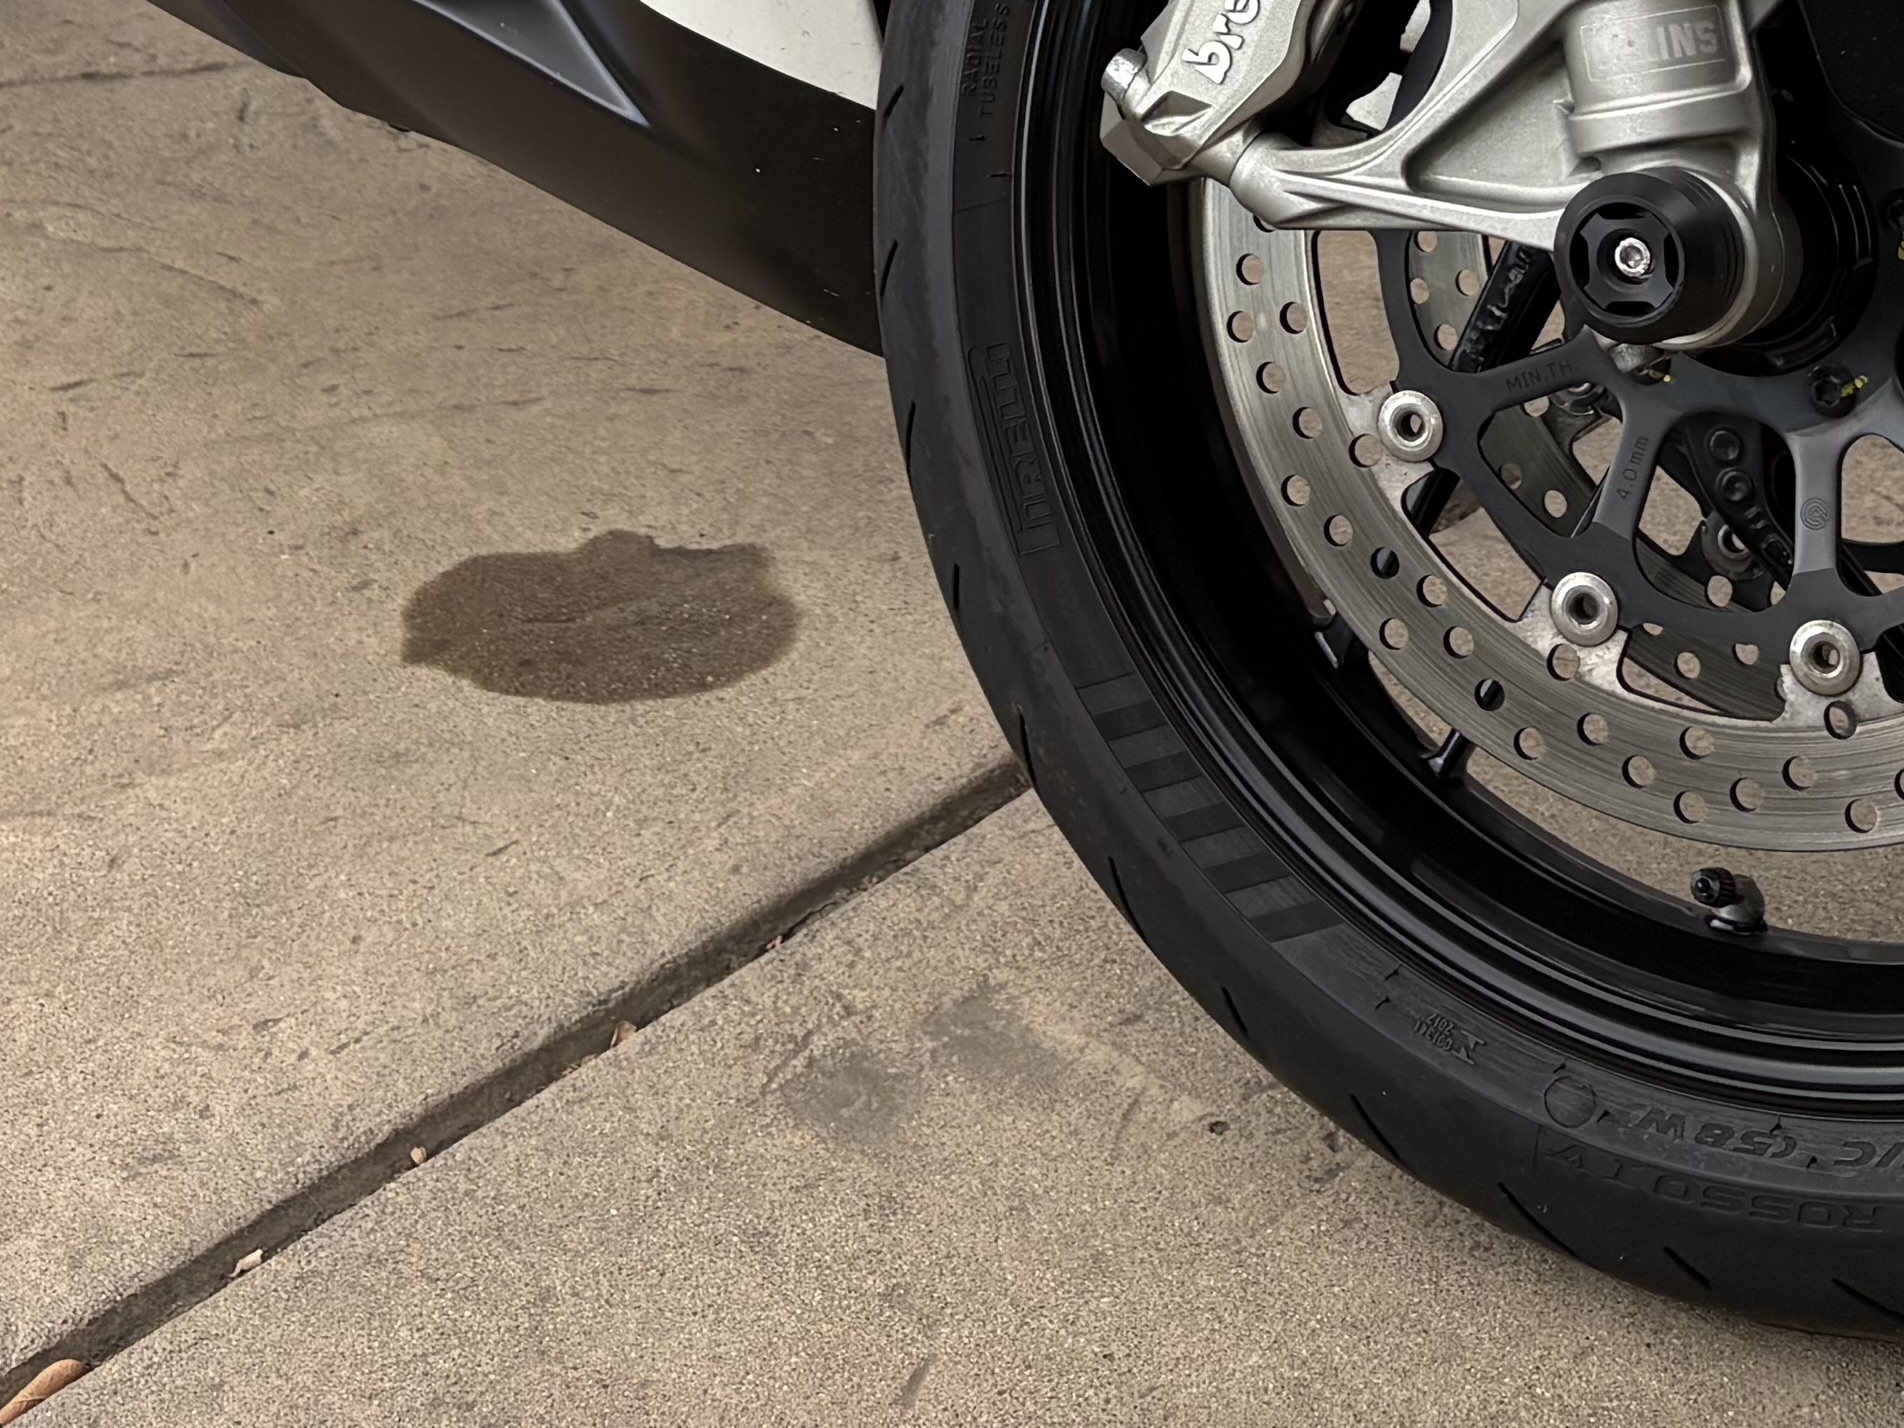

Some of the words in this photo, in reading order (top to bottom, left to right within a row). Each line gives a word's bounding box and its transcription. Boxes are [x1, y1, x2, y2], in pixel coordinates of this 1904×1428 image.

[976, 1, 1013, 121] TUBELESS
[968, 341, 1060, 556] PIRELLI
[1650, 1175, 1887, 1233] ROSSO
